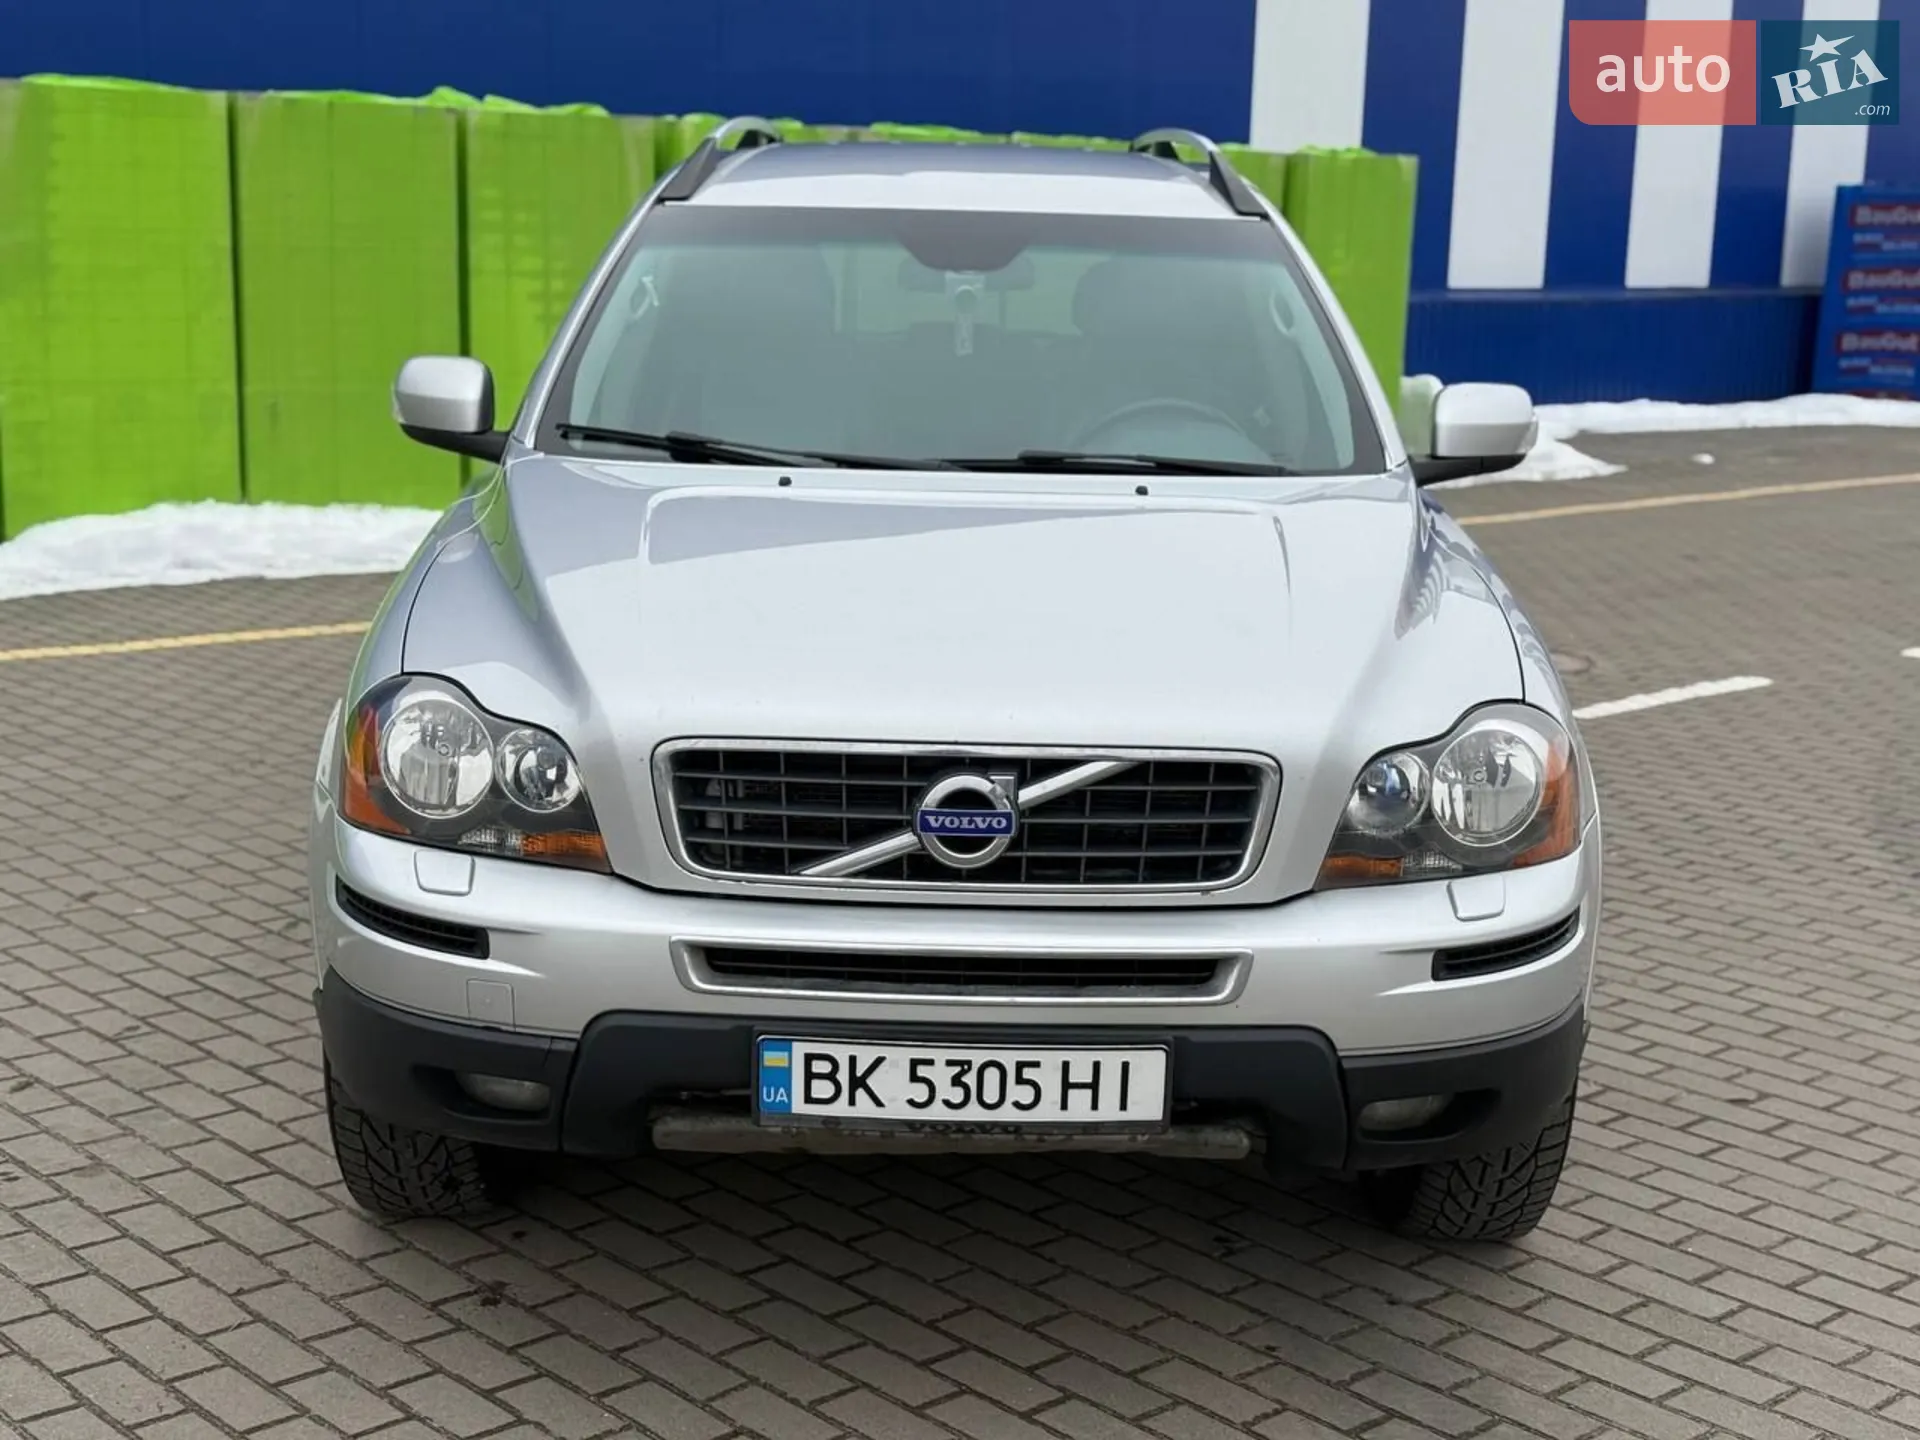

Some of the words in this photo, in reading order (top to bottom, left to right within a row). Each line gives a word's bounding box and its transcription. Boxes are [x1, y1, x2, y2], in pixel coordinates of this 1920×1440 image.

[925, 815, 1008, 829] VOLVO
[803, 1052, 888, 1108] BK
[905, 1058, 1042, 1111] 5305
[1060, 1060, 1130, 1112] HI
[762, 1087, 789, 1104] UA
